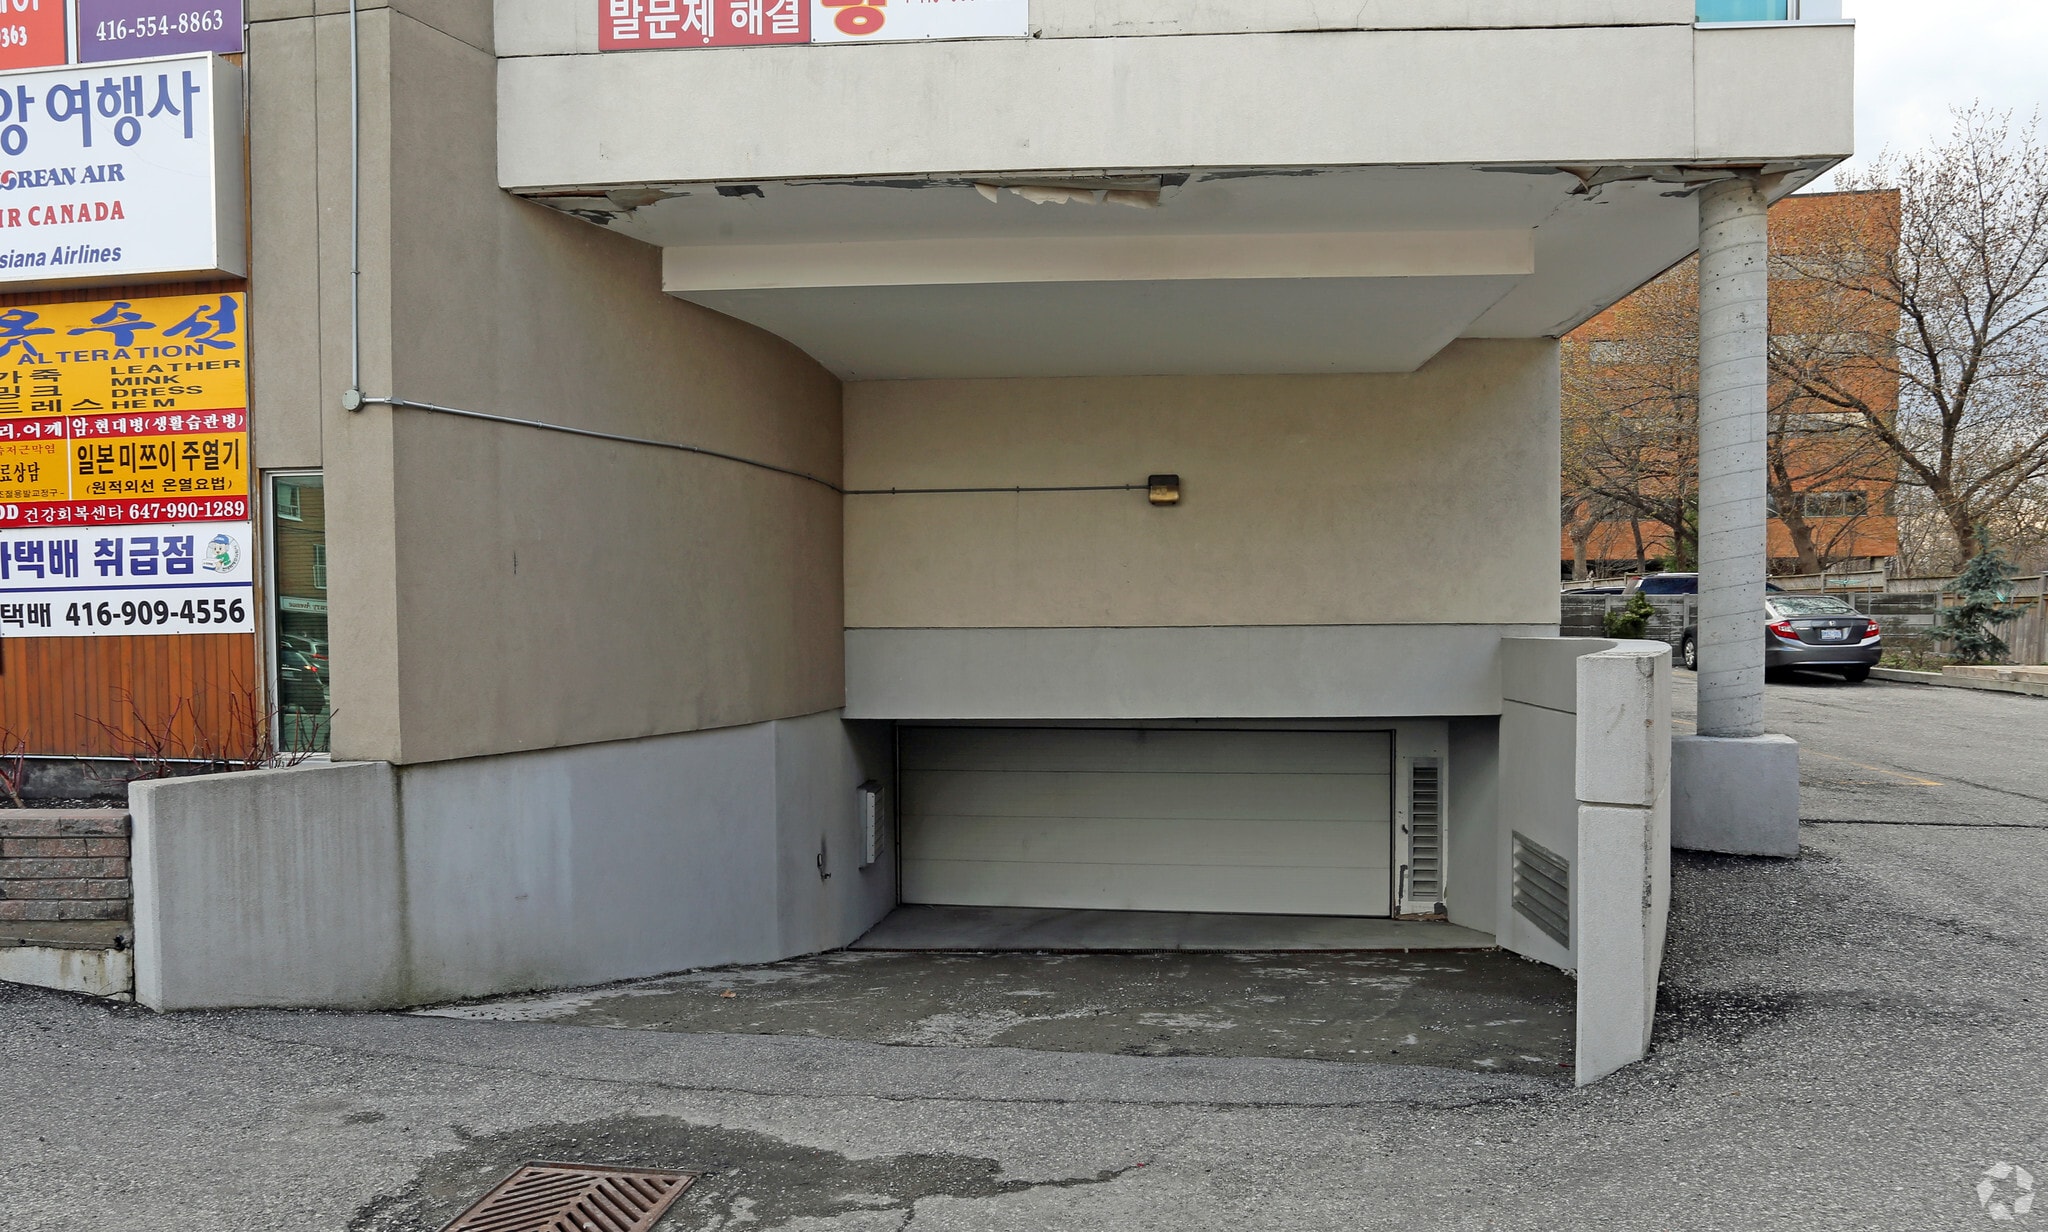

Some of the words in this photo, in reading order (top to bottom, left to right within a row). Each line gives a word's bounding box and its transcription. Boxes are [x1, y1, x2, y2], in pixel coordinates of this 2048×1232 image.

[0, 24, 28, 48] 363
[96, 9, 224, 42] 416-554-8863
[46, 70, 201, 148] 여행사
[0, 166, 76, 191] OREAN
[80, 163, 126, 185] AIR
[28, 200, 125, 227] CANADA
[50, 244, 122, 266] Airlines
[17, 344, 204, 366] ALTERATION
[110, 359, 241, 375] LEATHER
[111, 374, 180, 387] MINK
[111, 385, 204, 398] DRESS
[24, 504, 124, 525] 건강회복센타
[129, 501, 245, 520] 647-990-1289
[94, 535, 194, 577] 취급점
[0, 603, 52, 628] 택배
[65, 598, 246, 627] 416-909-4556
